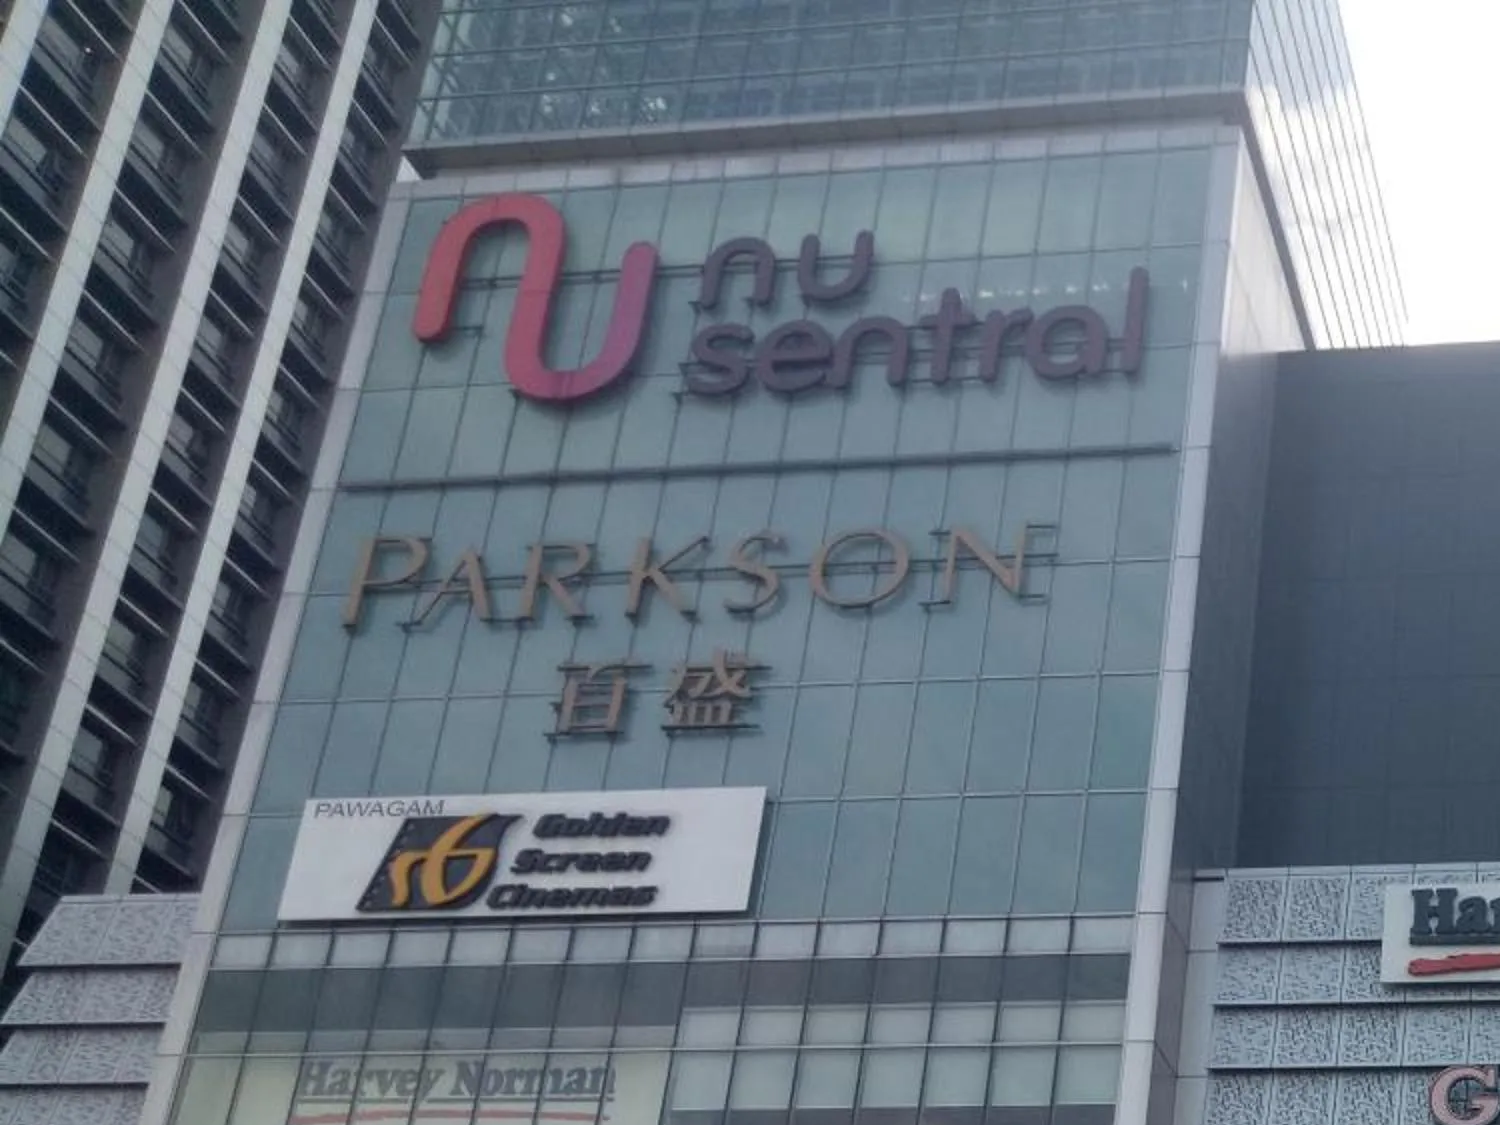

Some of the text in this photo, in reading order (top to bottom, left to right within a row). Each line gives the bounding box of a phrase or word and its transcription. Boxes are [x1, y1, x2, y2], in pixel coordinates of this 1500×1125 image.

[698, 230, 875, 312] nu
[686, 266, 1149, 396] sentral
[343, 523, 1045, 630] PARKSON
[552, 648, 758, 738] 百盛
[314, 799, 446, 819] PAWAGAM
[532, 812, 671, 839] Golden
[510, 848, 653, 874] Screen
[486, 883, 659, 910] Cinemas
[300, 1059, 616, 1105] Harvey Norman
